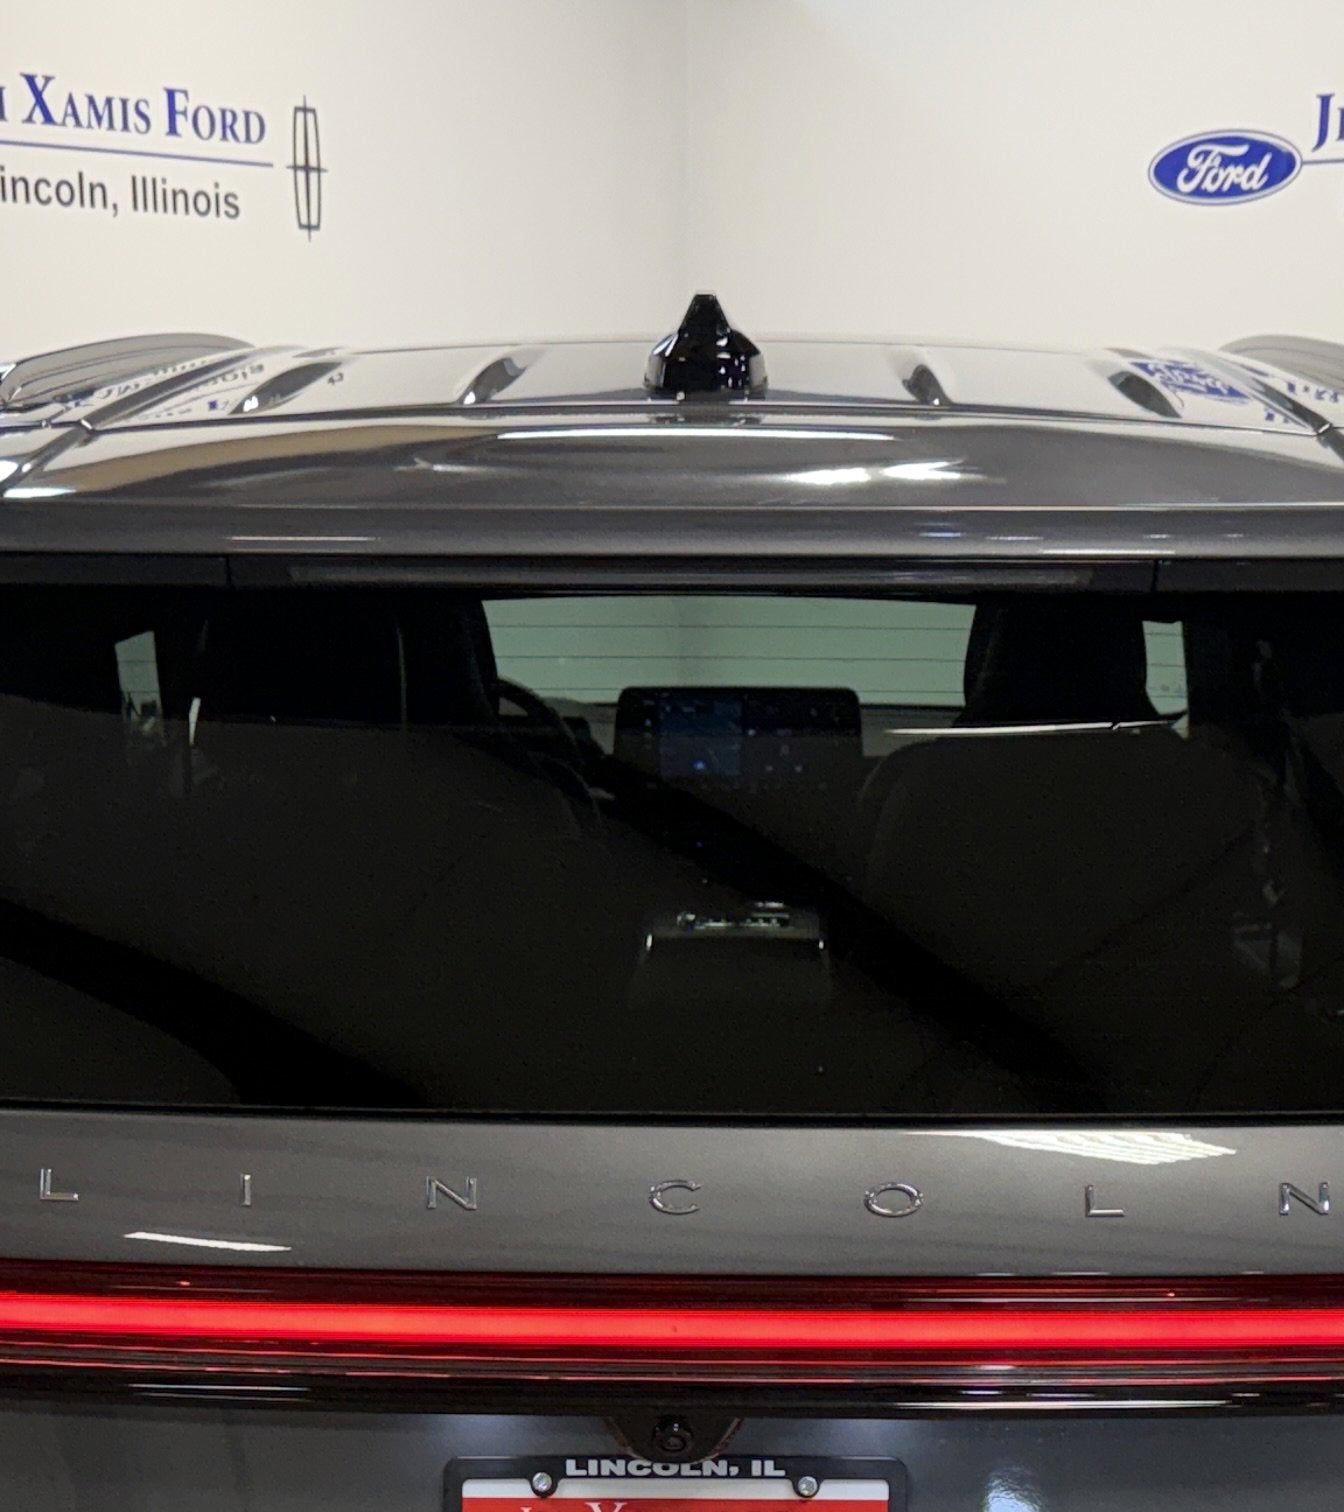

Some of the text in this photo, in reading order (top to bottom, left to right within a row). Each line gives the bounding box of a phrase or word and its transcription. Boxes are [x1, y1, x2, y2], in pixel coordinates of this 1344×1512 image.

[19, 72, 151, 135] XAMIS
[163, 87, 267, 145] FORD
[1176, 144, 1271, 194] Ford
[131, 174, 240, 220] Illinois
[565, 1459, 786, 1477] LINCOLN, IL
